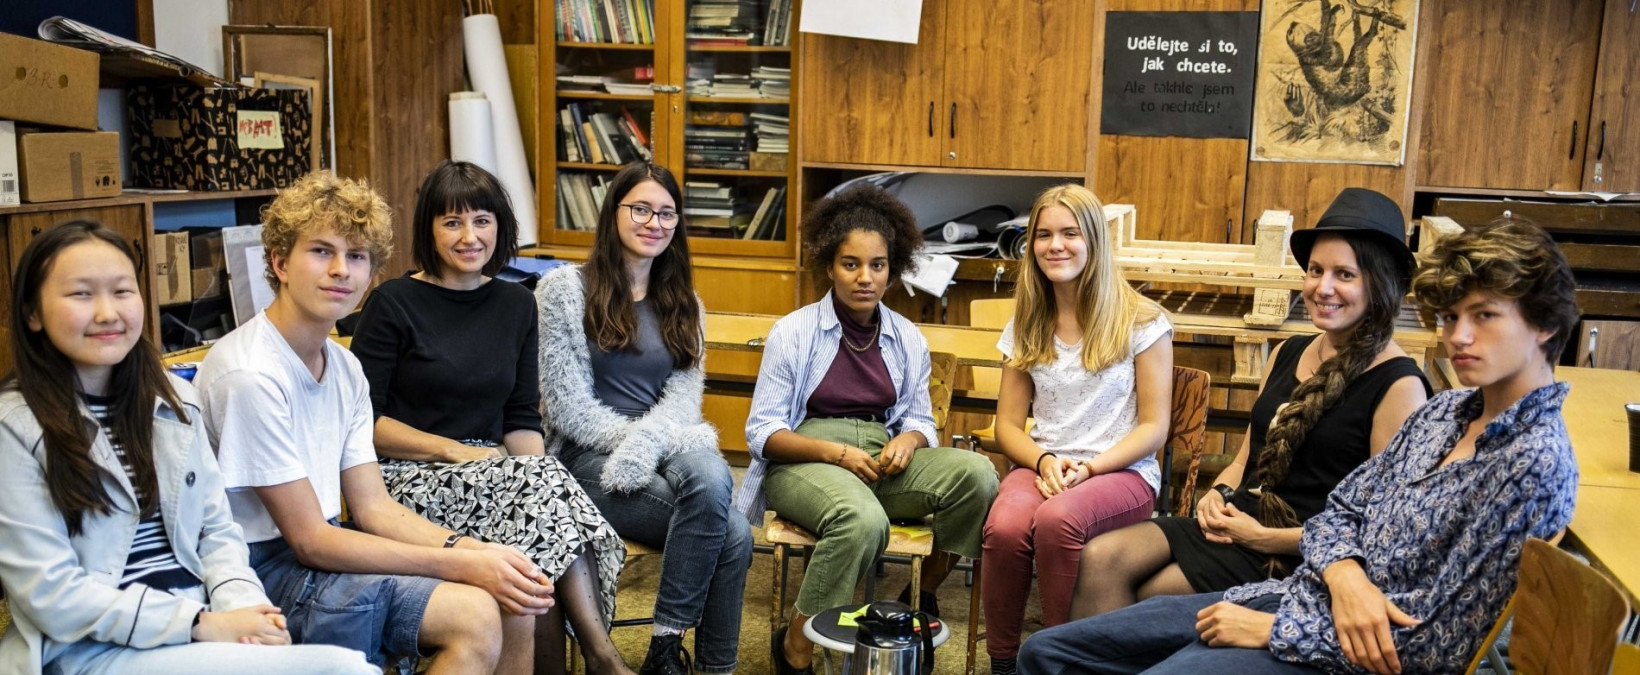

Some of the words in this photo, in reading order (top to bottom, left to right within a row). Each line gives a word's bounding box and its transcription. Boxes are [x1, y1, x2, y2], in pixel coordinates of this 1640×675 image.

[1126, 35, 1189, 56] Udělejte
[1198, 40, 1211, 53] si
[1218, 40, 1238, 56] to,
[1141, 57, 1165, 73] jak
[1176, 58, 1232, 73] chcete.
[1124, 81, 1146, 94] Ale
[1154, 81, 1193, 95] takhle
[1202, 84, 1235, 99] jsem
[1141, 101, 1155, 113] to
